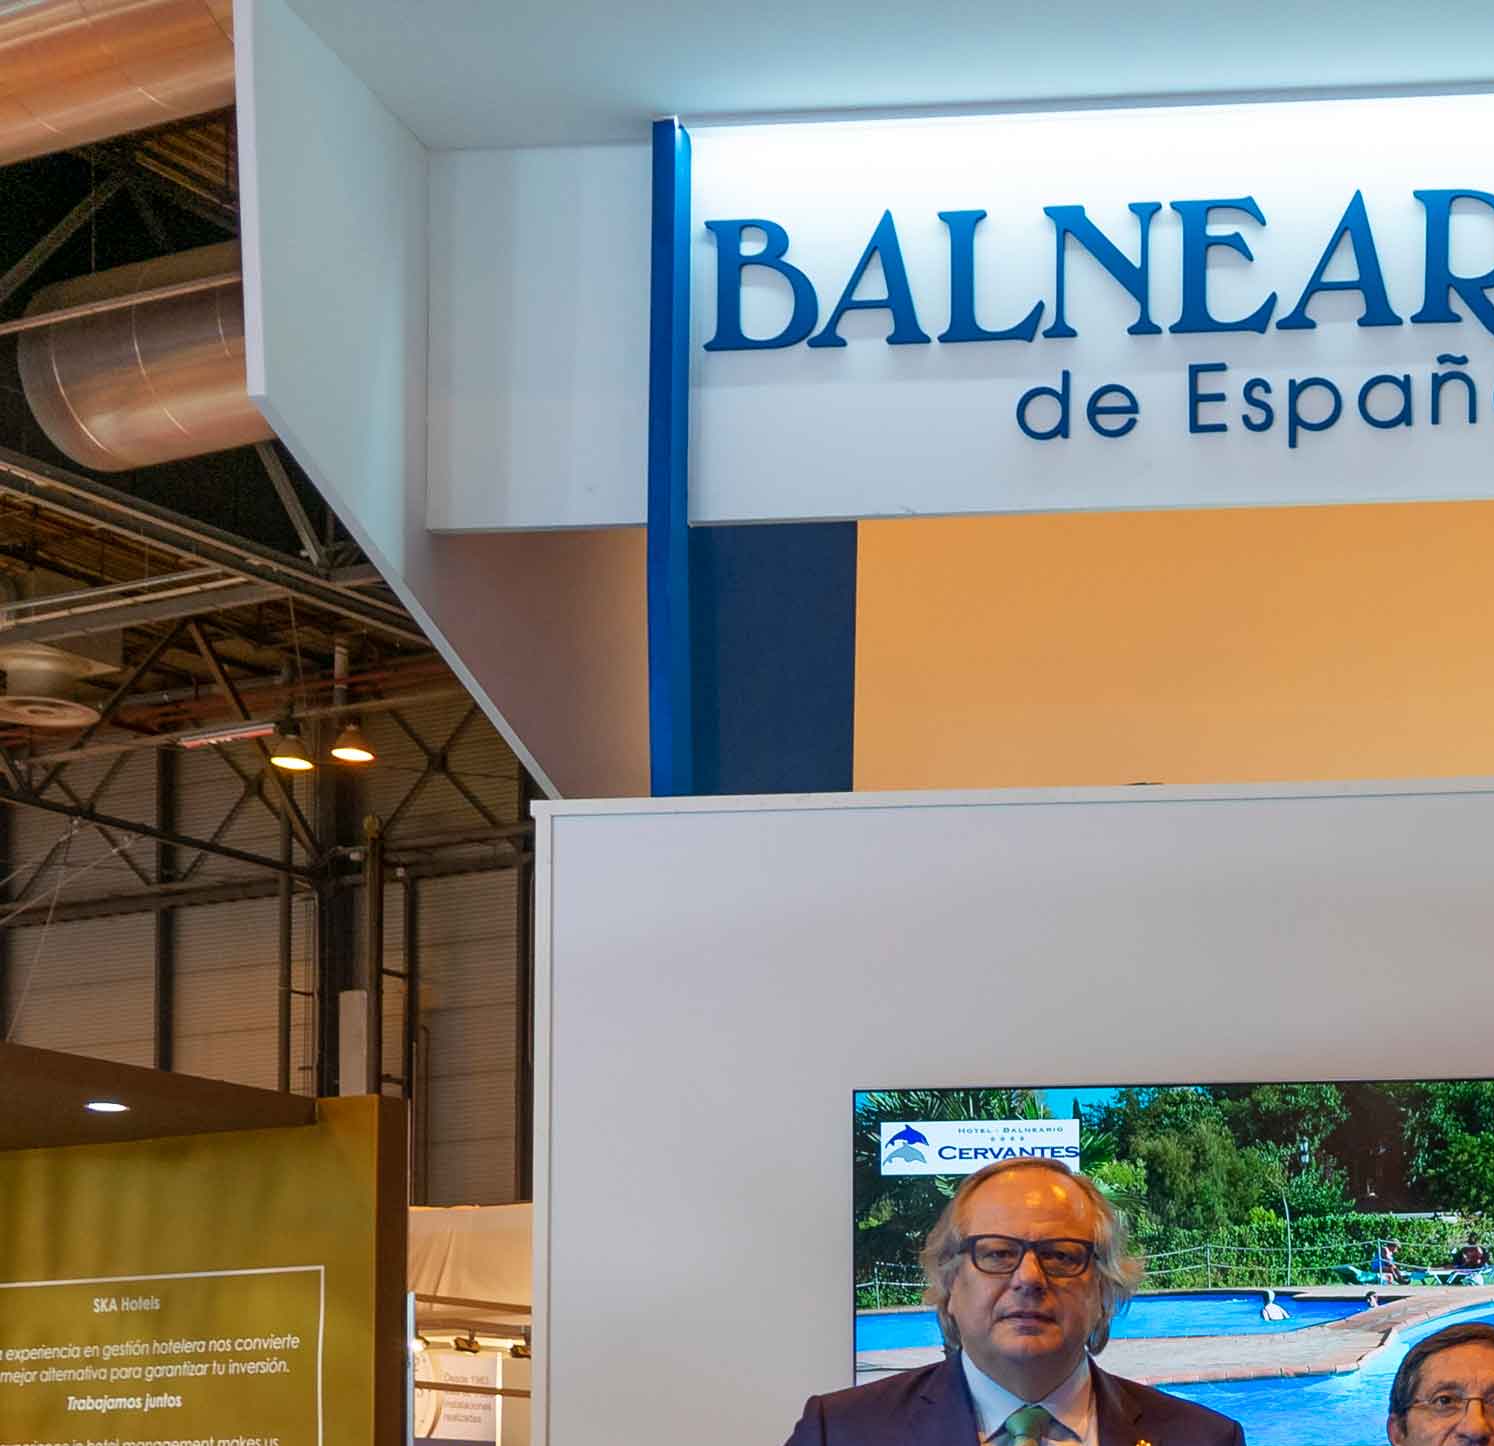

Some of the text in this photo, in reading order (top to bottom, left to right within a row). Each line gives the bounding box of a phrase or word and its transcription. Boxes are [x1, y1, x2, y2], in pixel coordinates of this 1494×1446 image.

[1015, 369, 1140, 441] de
[938, 1146, 1080, 1160] CERVANTES
[93, 1296, 160, 1313] SKA Hotels
[5, 1344, 81, 1362] experiencia
[84, 1345, 100, 1358] en
[103, 1340, 149, 1360] gestión
[152, 1338, 206, 1354] hotelera
[208, 1340, 232, 1352] nos
[234, 1334, 300, 1350] convierte
[0, 1357, 290, 1386] mejor alternativa para garantizar tu inversión.
[67, 1393, 182, 1413] Trabajamos juntos
